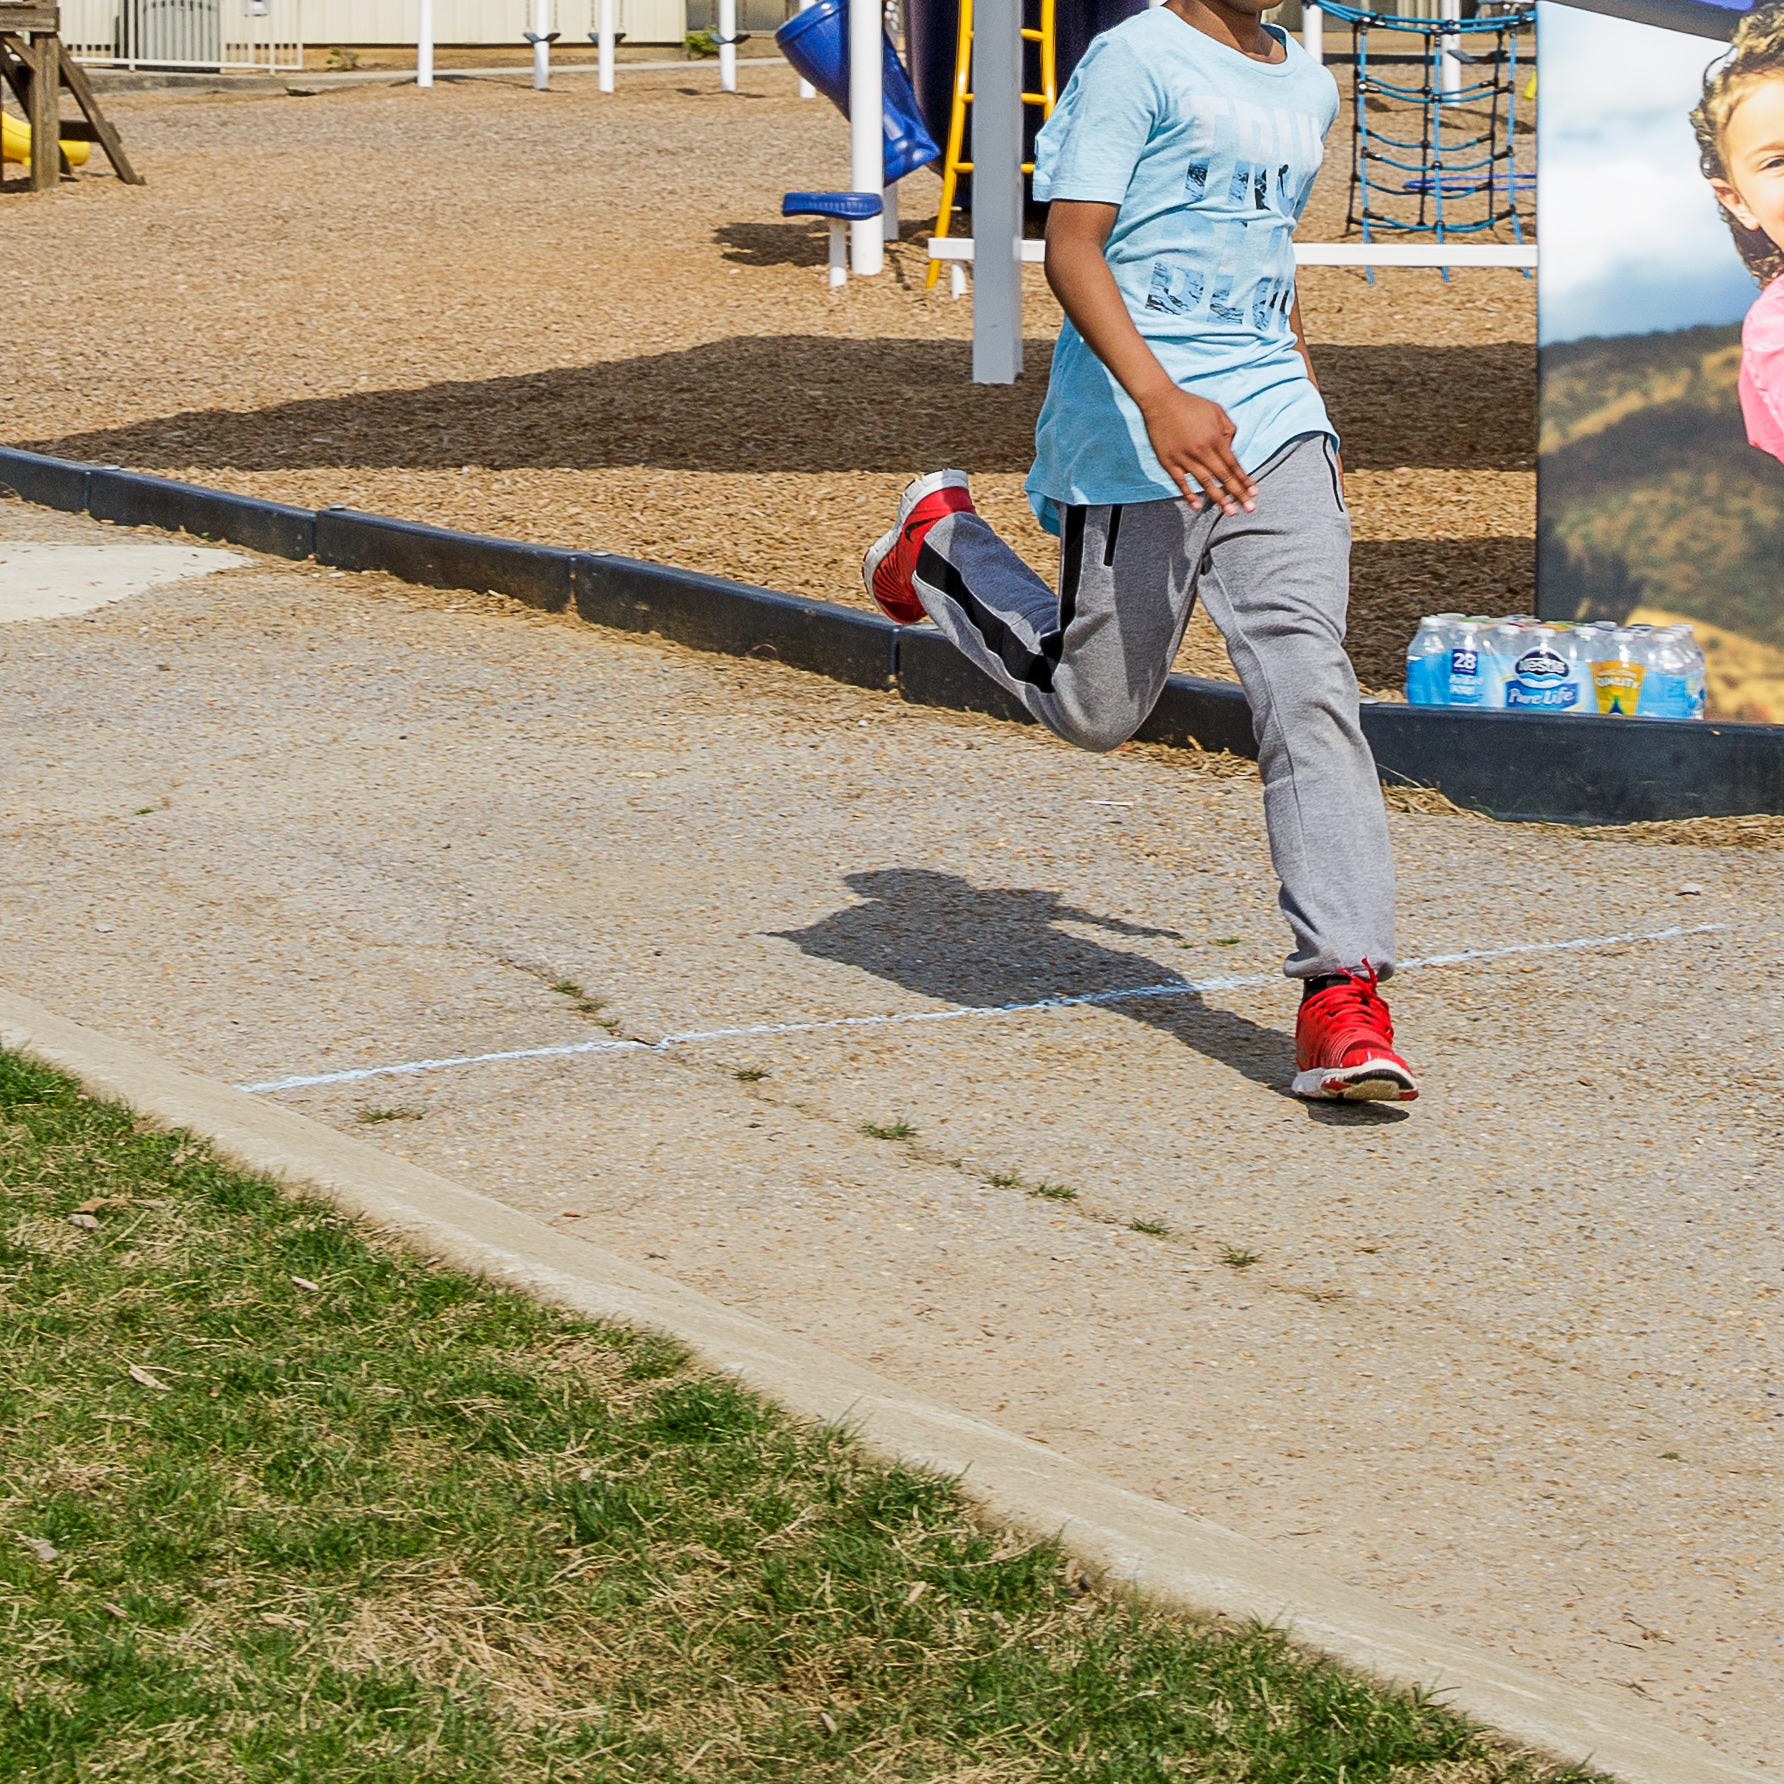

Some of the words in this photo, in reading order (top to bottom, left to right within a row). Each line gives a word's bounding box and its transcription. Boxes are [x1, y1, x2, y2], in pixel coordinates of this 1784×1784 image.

[1453, 652, 1477, 670] 28
[1508, 687, 1542, 705] Pure
[1543, 686, 1576, 705] Life
